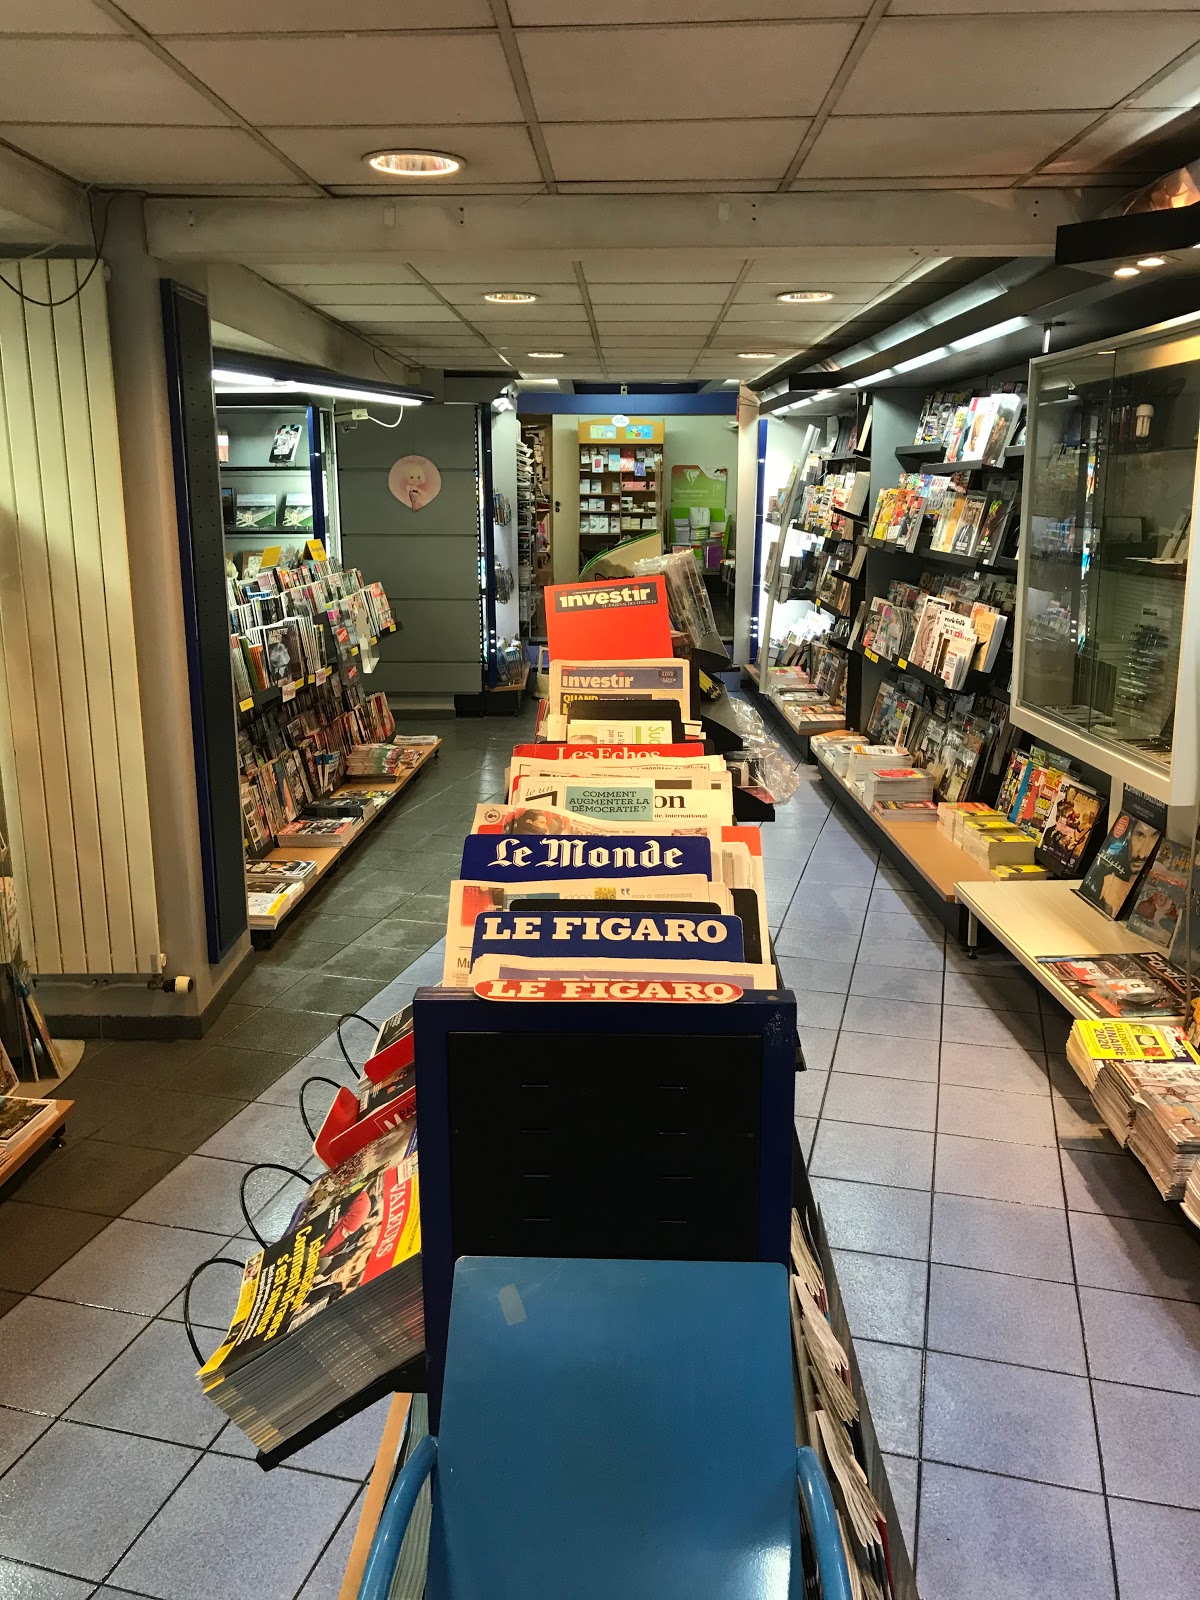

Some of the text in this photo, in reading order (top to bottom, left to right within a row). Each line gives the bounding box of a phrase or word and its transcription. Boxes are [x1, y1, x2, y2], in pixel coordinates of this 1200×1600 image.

[560, 585, 650, 608] investir
[562, 671, 634, 688] investir
[569, 798, 650, 806] AUGMENTER LA
[582, 790, 637, 798] COMMENT
[487, 838, 684, 869] Le Monde
[482, 917, 728, 943] LE FIGARO
[1140, 953, 1186, 978] Ford
[487, 980, 548, 998] LE
[562, 980, 734, 1000] FIGARO
[1093, 1027, 1112, 1050] 2020
[1102, 1022, 1126, 1056] LUNAIRE
[1113, 1023, 1136, 1056] CALENDRIER
[375, 1182, 406, 1259] VALEURS
[263, 1225, 313, 1342] Comment la France
[290, 1233, 326, 1312] Islamisation
[253, 1285, 283, 1338] soumise
